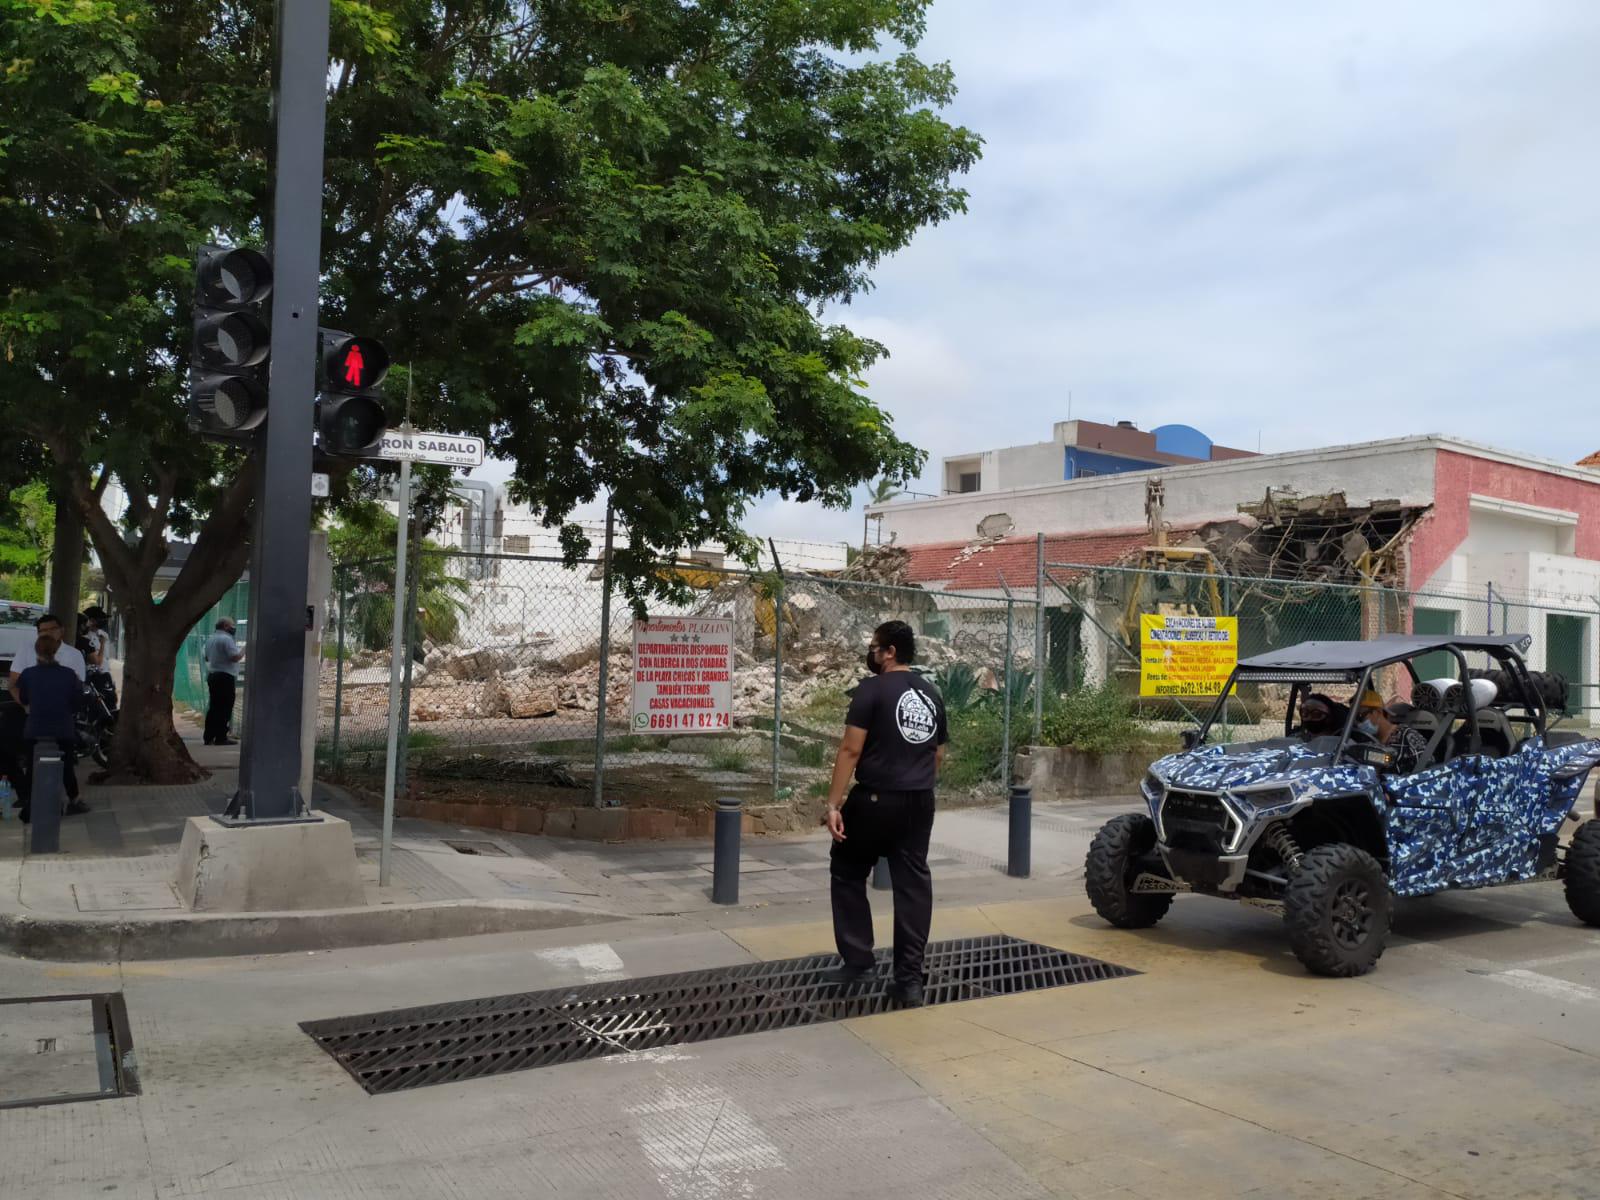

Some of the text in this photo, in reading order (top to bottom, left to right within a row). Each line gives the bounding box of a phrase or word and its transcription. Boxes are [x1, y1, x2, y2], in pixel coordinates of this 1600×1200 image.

[418, 440, 476, 454] SABALO
[638, 643, 729, 656] DEPARTAMENTOS DISPONIBLES
[639, 657, 727, 668] CON ALBERCA A DOS CUADRAS
[637, 671, 646, 682] DE
[646, 671, 654, 682] LA
[655, 671, 672, 682] PLAYA
[673, 671, 696, 682] CHICOS
[683, 684, 710, 695] TENEMOS
[649, 698, 669, 709] CASAS
[650, 712, 729, 728] 6691 47 82 24
[902, 710, 934, 727] PIZZA
